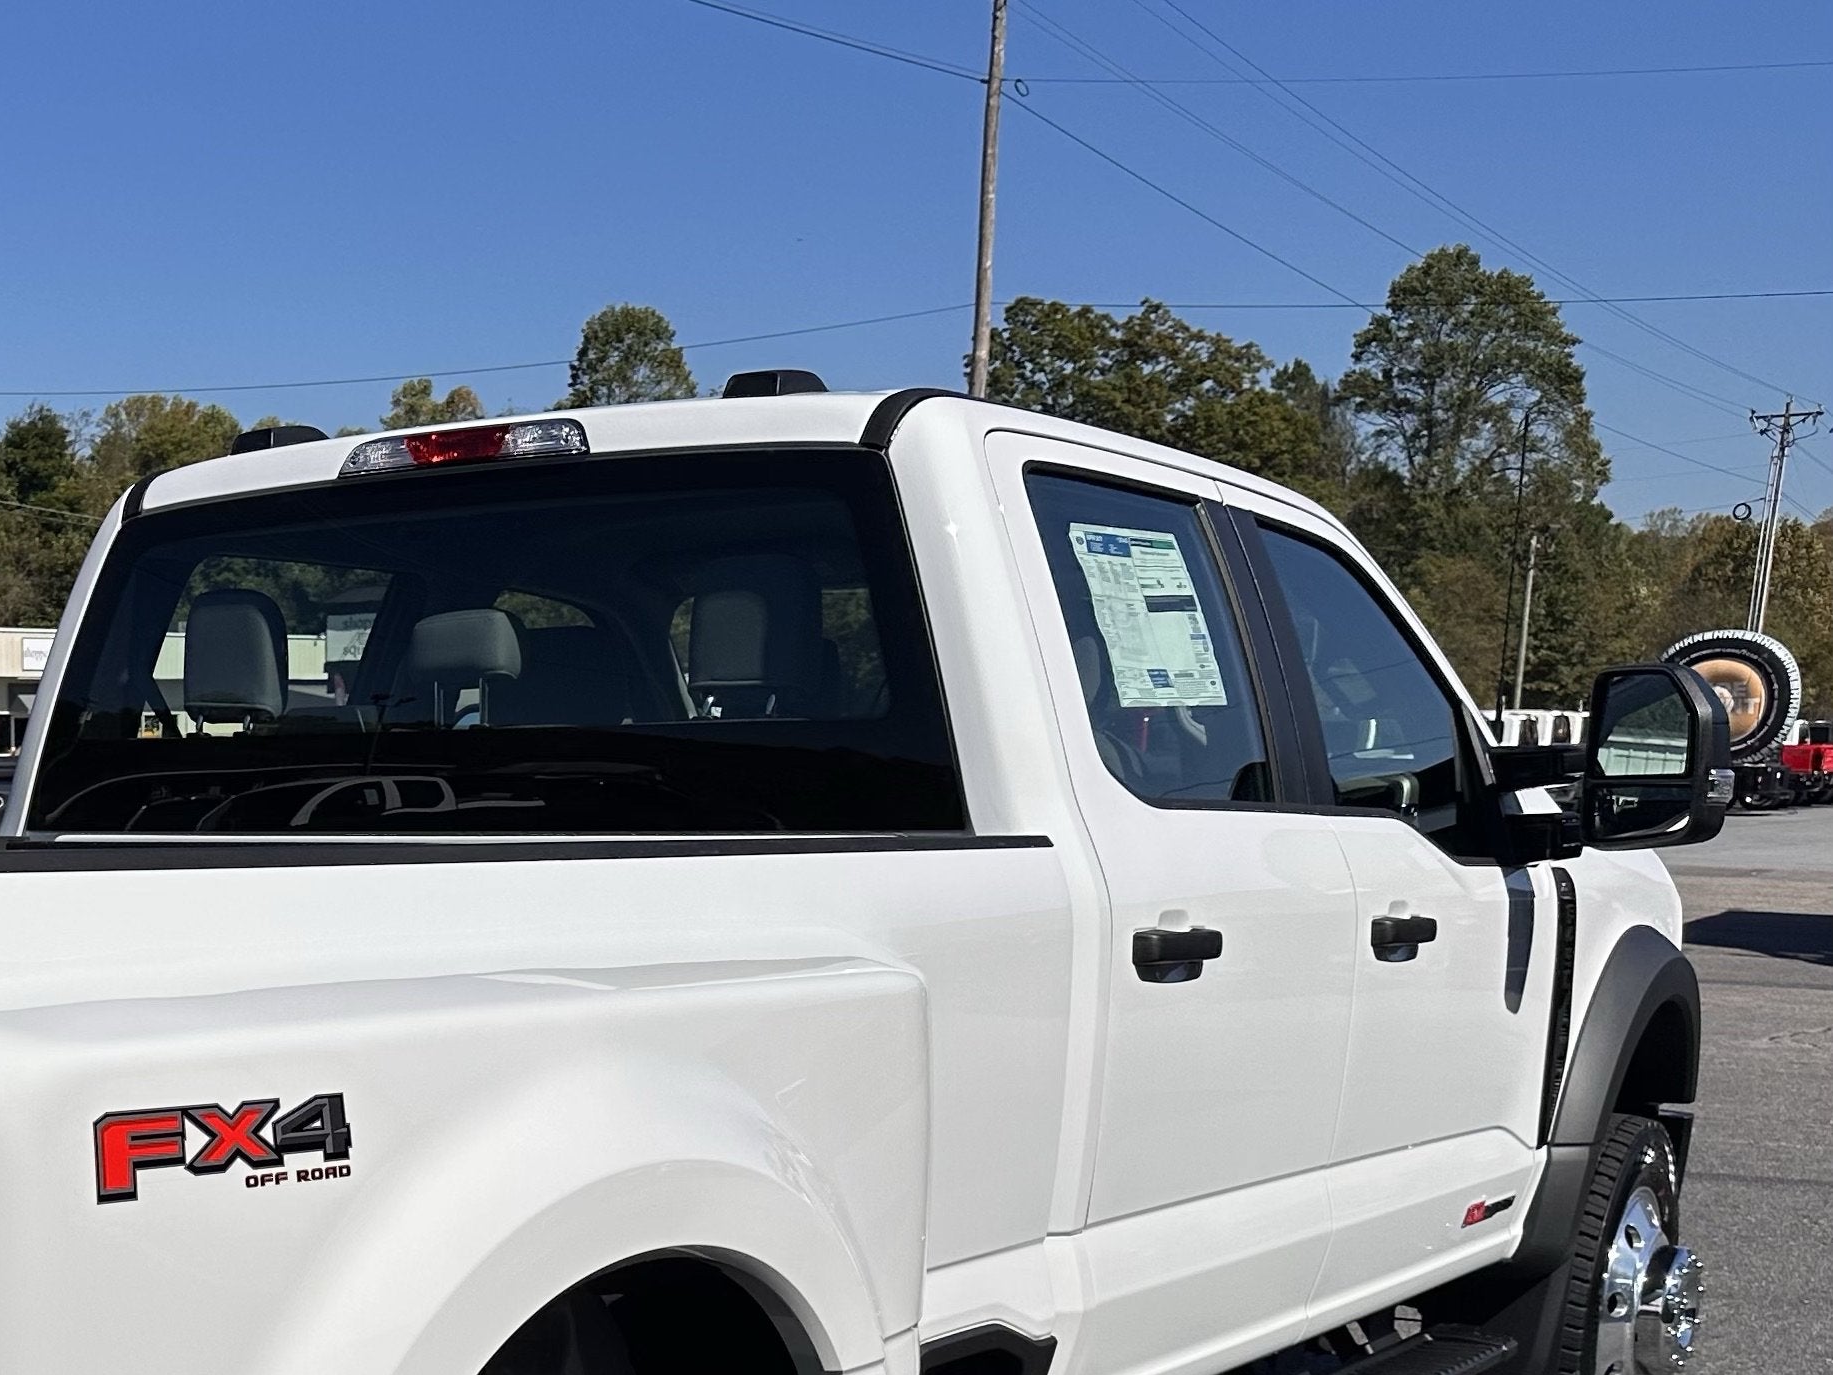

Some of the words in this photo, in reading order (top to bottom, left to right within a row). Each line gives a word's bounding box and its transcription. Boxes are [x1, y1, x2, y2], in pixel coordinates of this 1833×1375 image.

[93, 1091, 353, 1205] FX4
[245, 1171, 289, 1188] OFF
[296, 1164, 352, 1183] ROAD
